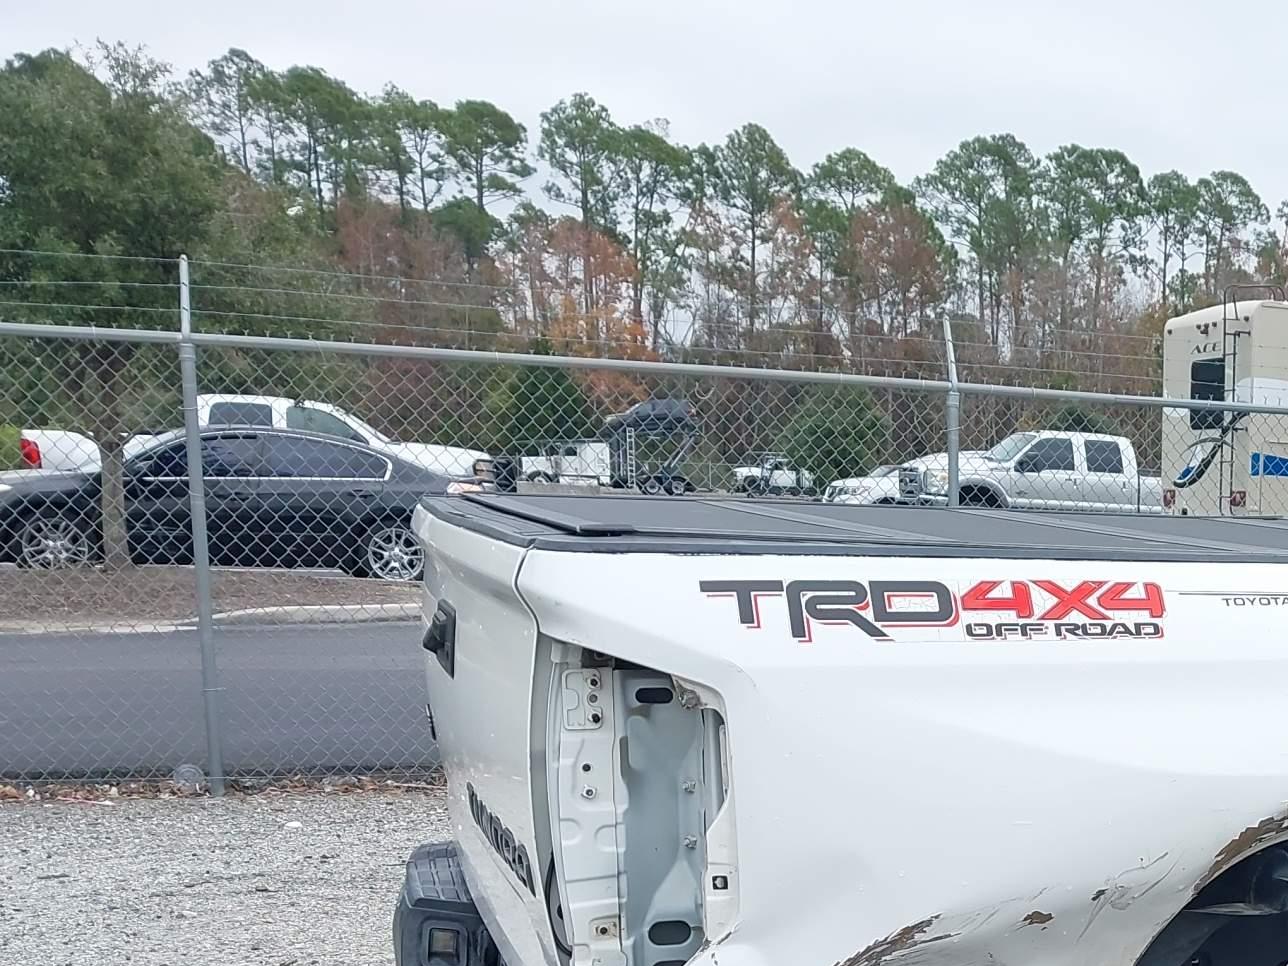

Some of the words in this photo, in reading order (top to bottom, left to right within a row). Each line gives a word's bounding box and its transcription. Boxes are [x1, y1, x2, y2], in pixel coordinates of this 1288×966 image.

[700, 580, 960, 643] TRD
[961, 580, 1166, 620] 4X4
[965, 622, 1049, 640] OFF
[1054, 622, 1165, 640] ROAD
